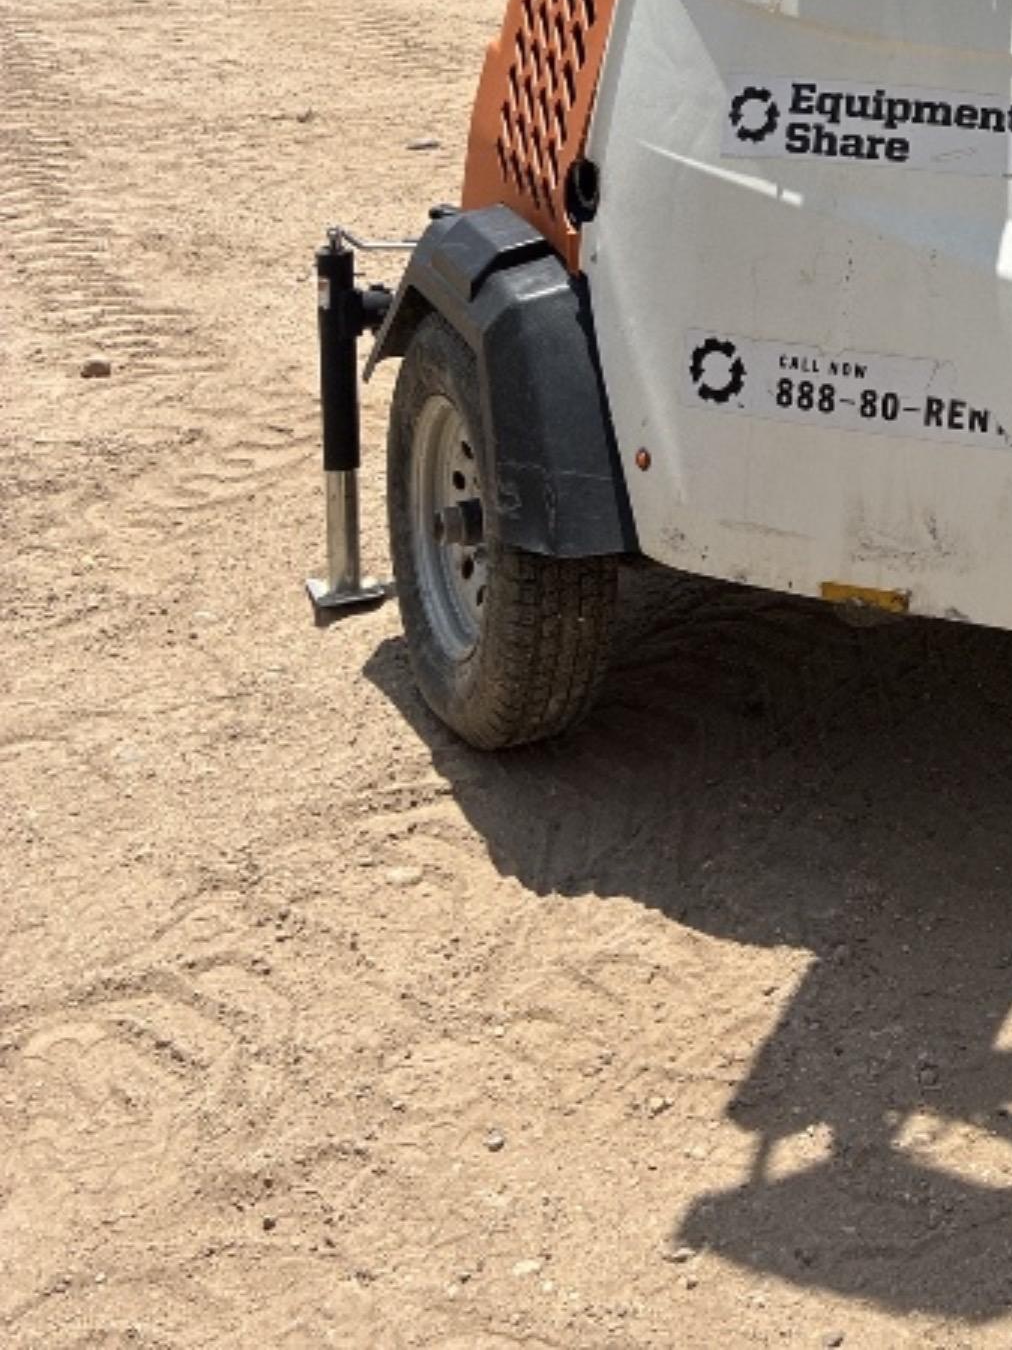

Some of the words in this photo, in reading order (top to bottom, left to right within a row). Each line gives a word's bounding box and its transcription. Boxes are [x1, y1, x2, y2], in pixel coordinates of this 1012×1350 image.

[785, 122, 910, 162] Share
[779, 355, 820, 373] CALL
[827, 361, 868, 379] NOW
[776, 377, 1006, 437] 888-80-REN
